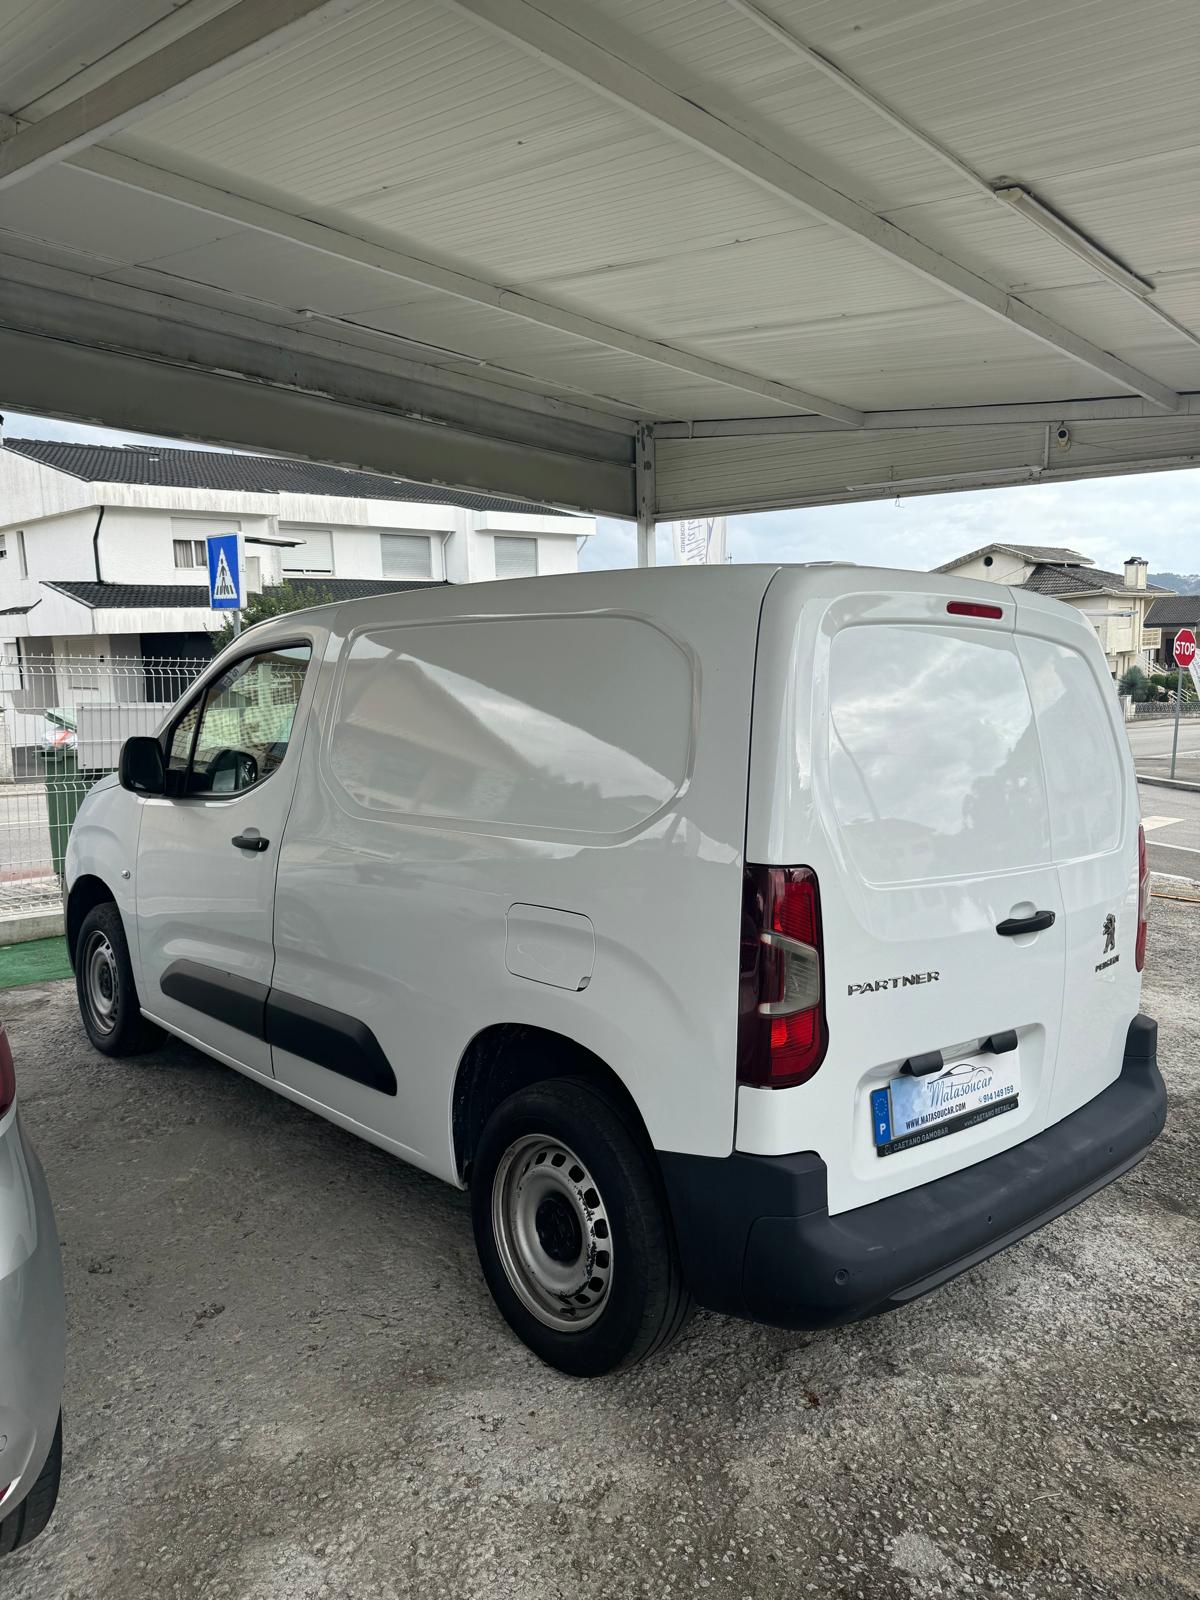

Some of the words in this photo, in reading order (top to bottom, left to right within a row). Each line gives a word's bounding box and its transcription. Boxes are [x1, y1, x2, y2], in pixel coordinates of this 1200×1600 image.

[1175, 640, 1195, 655] STOP
[847, 971, 940, 996] PARTNER
[927, 1076, 992, 1107] Matasoucar
[982, 1092, 993, 1103] 914
[993, 1088, 1004, 1099] 149
[1004, 1084, 1014, 1096] 159
[905, 1102, 966, 1130] WWW.MATASOUCAR.COM
[880, 1123, 887, 1135] P
[893, 1136, 920, 1151] CAETANO
